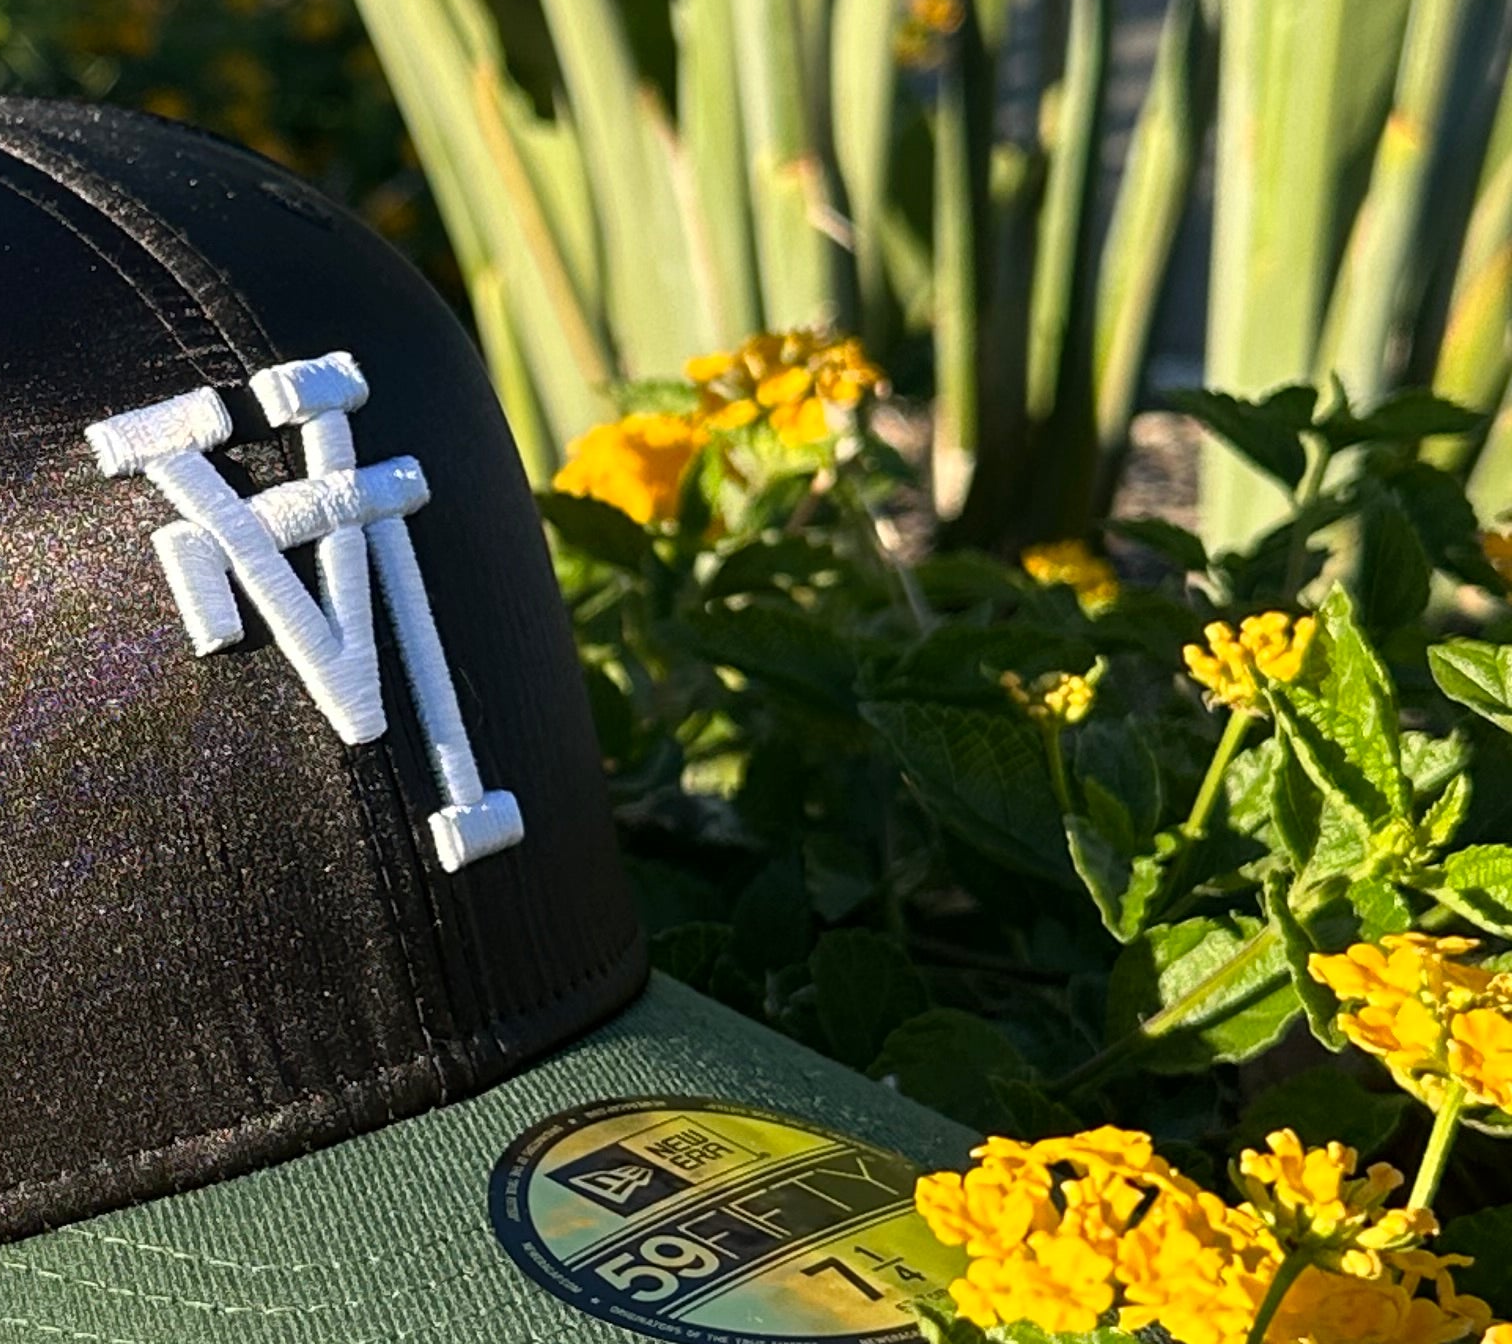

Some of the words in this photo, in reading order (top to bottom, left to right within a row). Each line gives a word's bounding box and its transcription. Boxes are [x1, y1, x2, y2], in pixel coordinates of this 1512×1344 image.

[644, 1129, 710, 1158] NEW
[668, 1143, 736, 1170] ERA
[594, 1157, 900, 1303] 59FIFTY
[799, 1255, 885, 1302] 7
[686, 1329, 701, 1339] OF
[706, 1332, 730, 1344] THE
